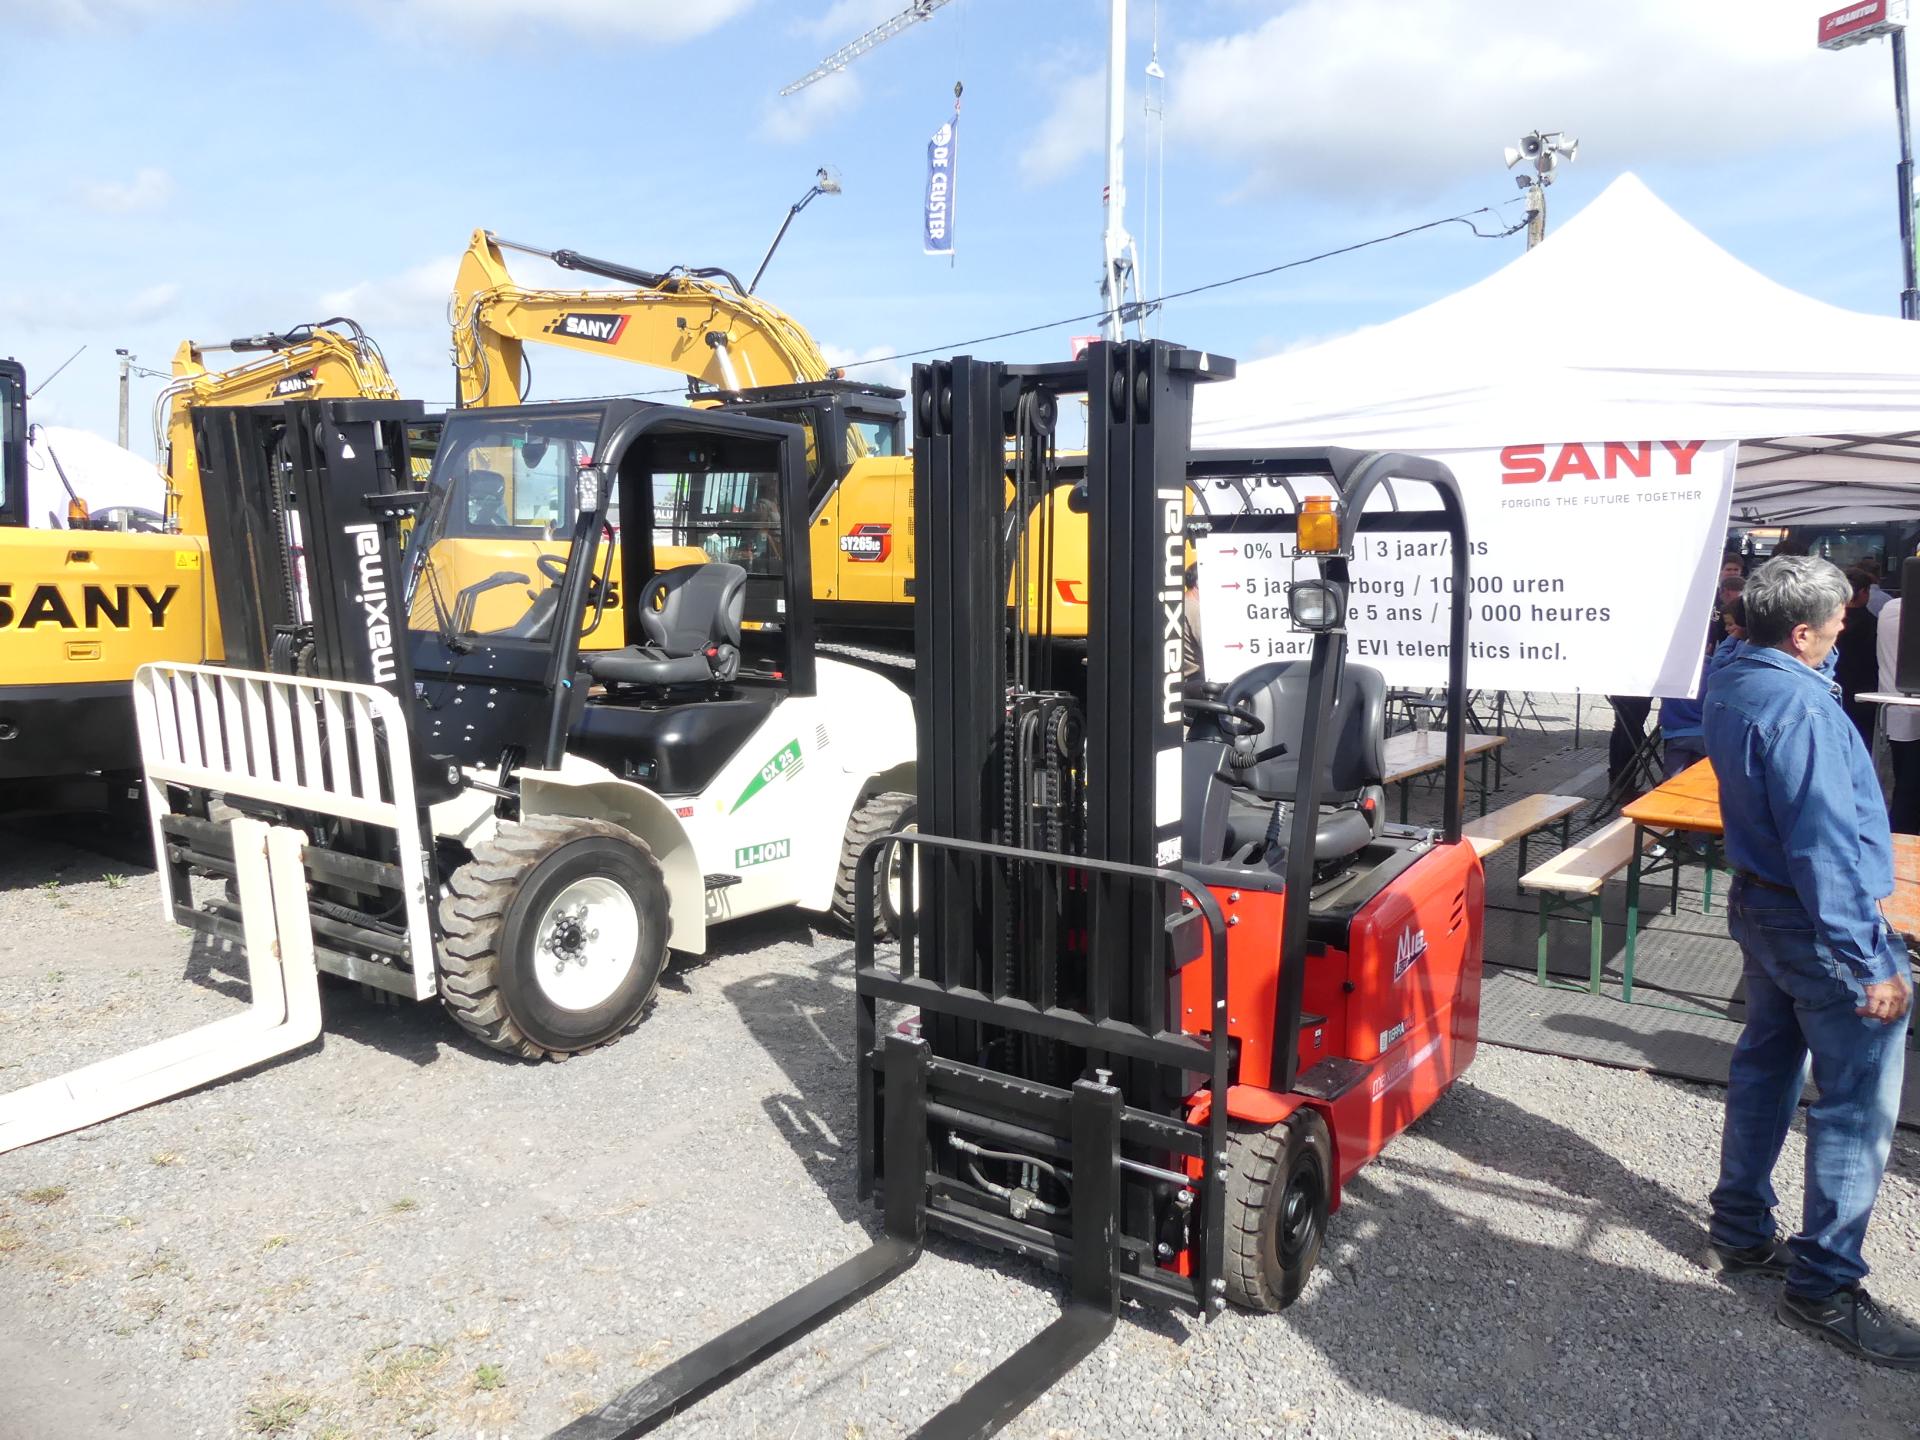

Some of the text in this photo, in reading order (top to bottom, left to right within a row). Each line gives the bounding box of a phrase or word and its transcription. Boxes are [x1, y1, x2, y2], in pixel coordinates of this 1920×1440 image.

[929, 147, 948, 240] DE CEUSTER
[566, 317, 612, 339] SANY
[1500, 439, 1706, 485] SANY
[1501, 490, 1702, 509] FORGING THE FUTURE TOGETHER
[1244, 542, 1272, 560] 0%
[1377, 541, 1388, 557] 3
[1246, 578, 1256, 594] 5
[1264, 577, 1293, 597] jaa
[1513, 578, 1564, 593] uren
[0, 584, 180, 630] ANY
[344, 524, 397, 684] maximal
[1157, 489, 1183, 724] maximal
[1367, 604, 1378, 620] 5
[1386, 607, 1423, 621] ans
[1482, 604, 1521, 621] 000
[1531, 604, 1611, 622] heures
[1250, 638, 1260, 654] 5
[1358, 639, 1388, 656] EVI
[1396, 640, 1510, 659] telemtics
[1520, 642, 1567, 660] incl.
[761, 748, 795, 782] CX 25
[738, 840, 788, 867] LI-ION
